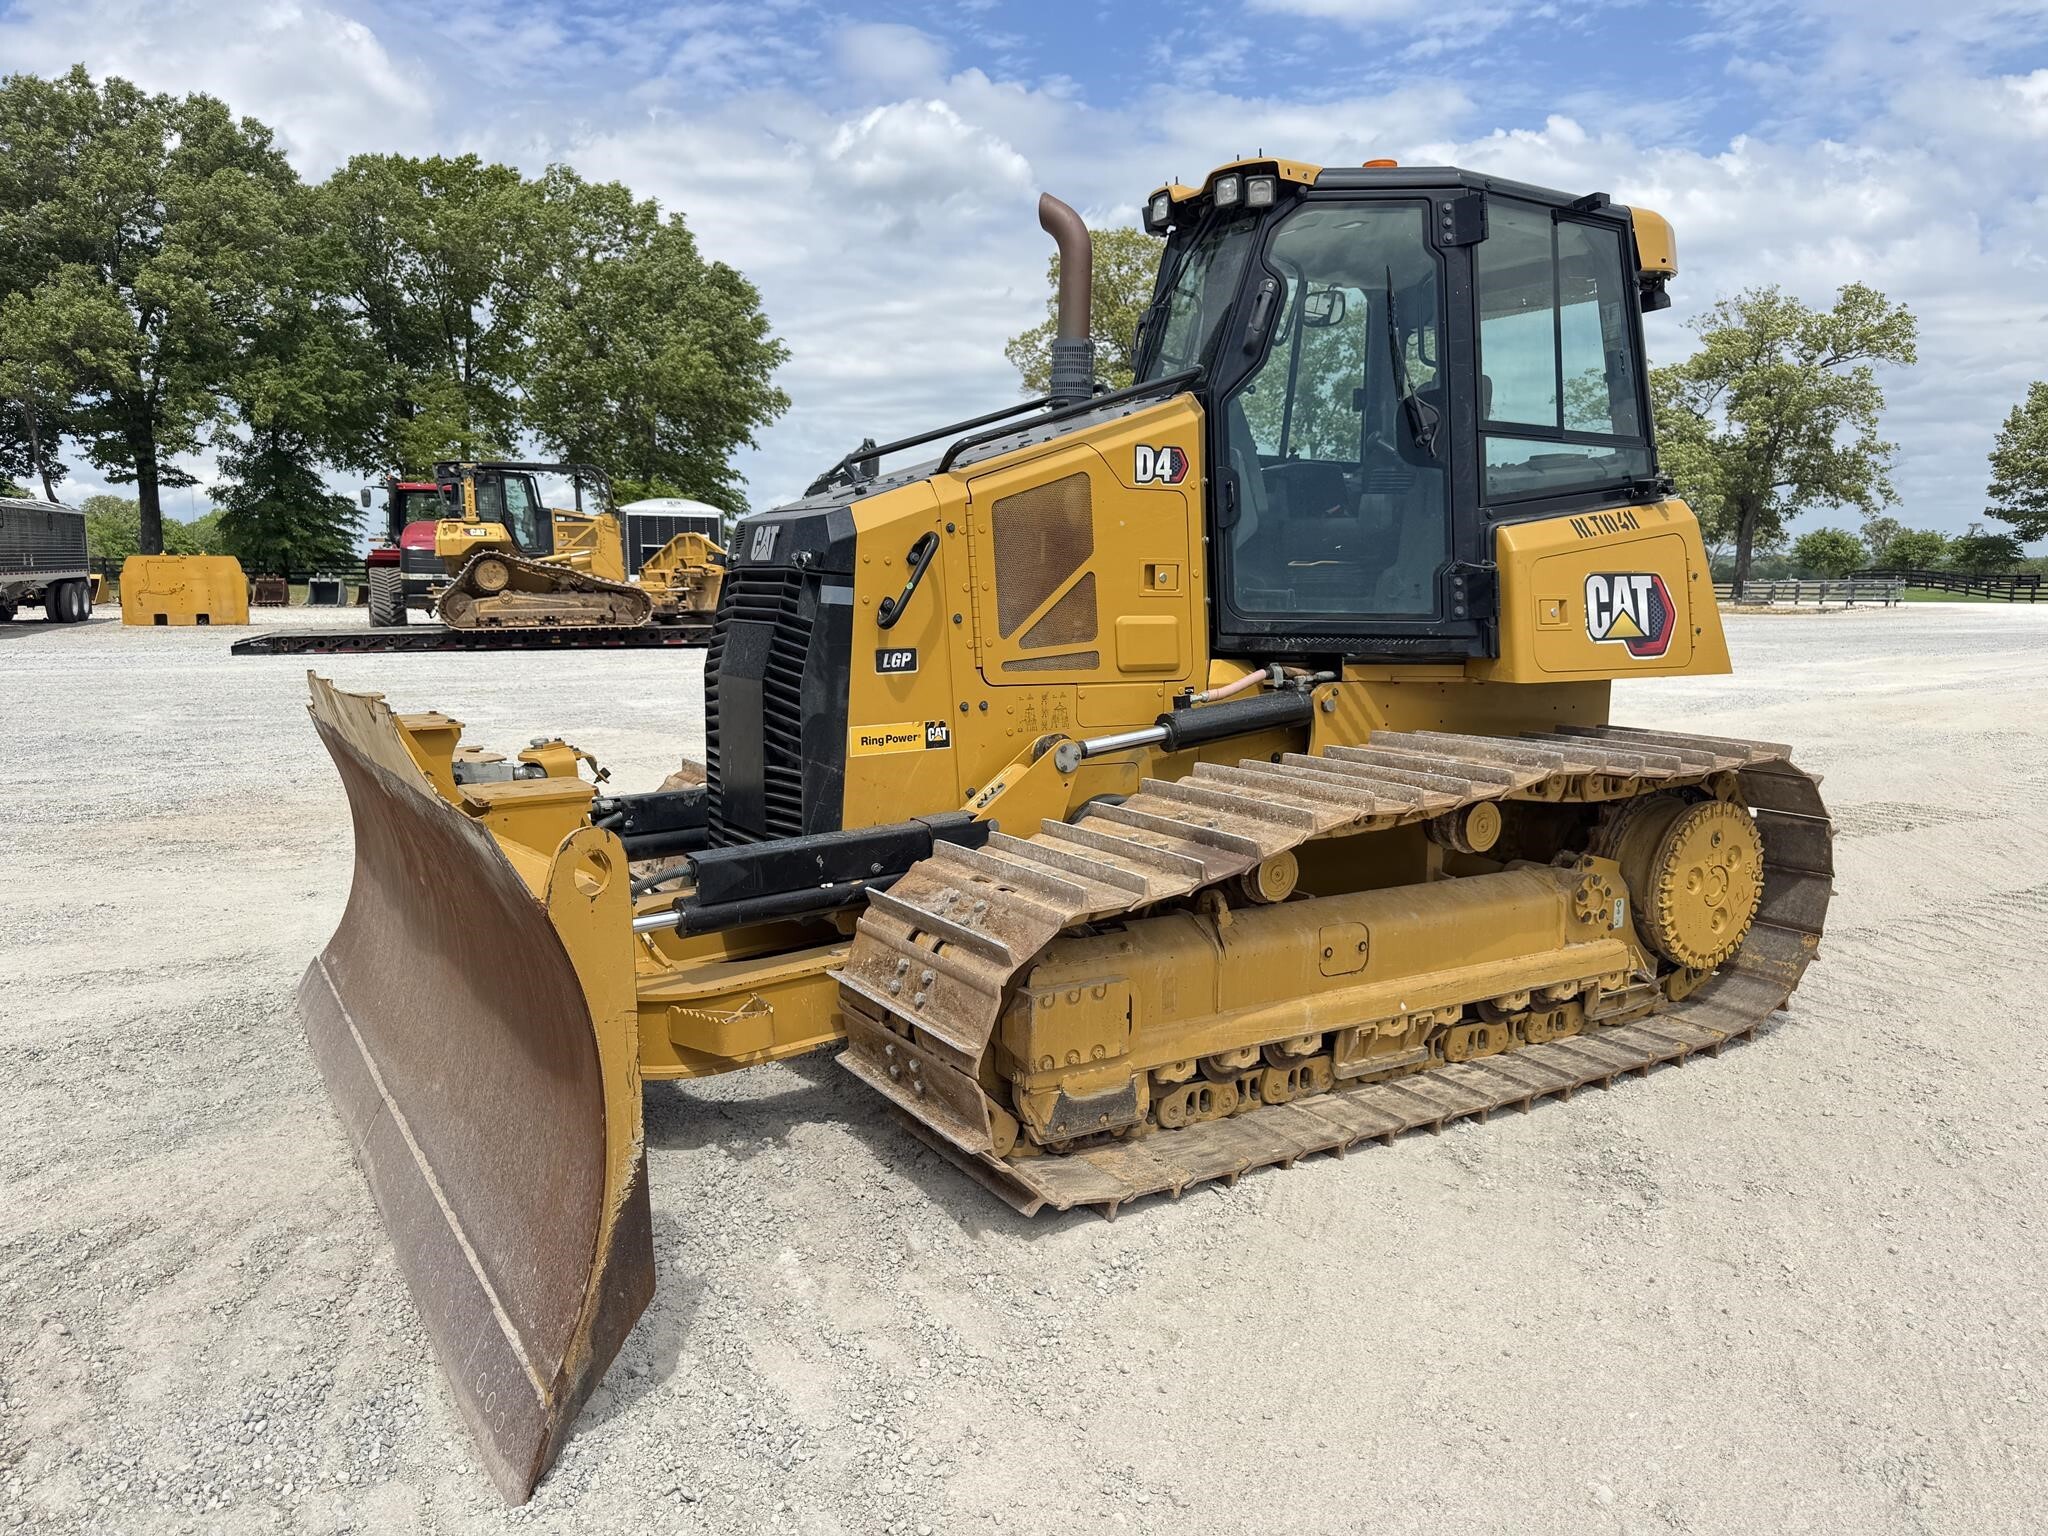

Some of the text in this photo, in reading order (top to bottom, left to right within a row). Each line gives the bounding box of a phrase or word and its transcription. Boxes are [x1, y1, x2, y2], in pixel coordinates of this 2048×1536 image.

[1136, 445, 1173, 482] D4
[750, 525, 780, 561] CAT
[1586, 574, 1653, 640] CAT
[882, 652, 912, 669] LGP
[860, 736, 885, 747] Ring
[927, 726, 947, 742] CAT
